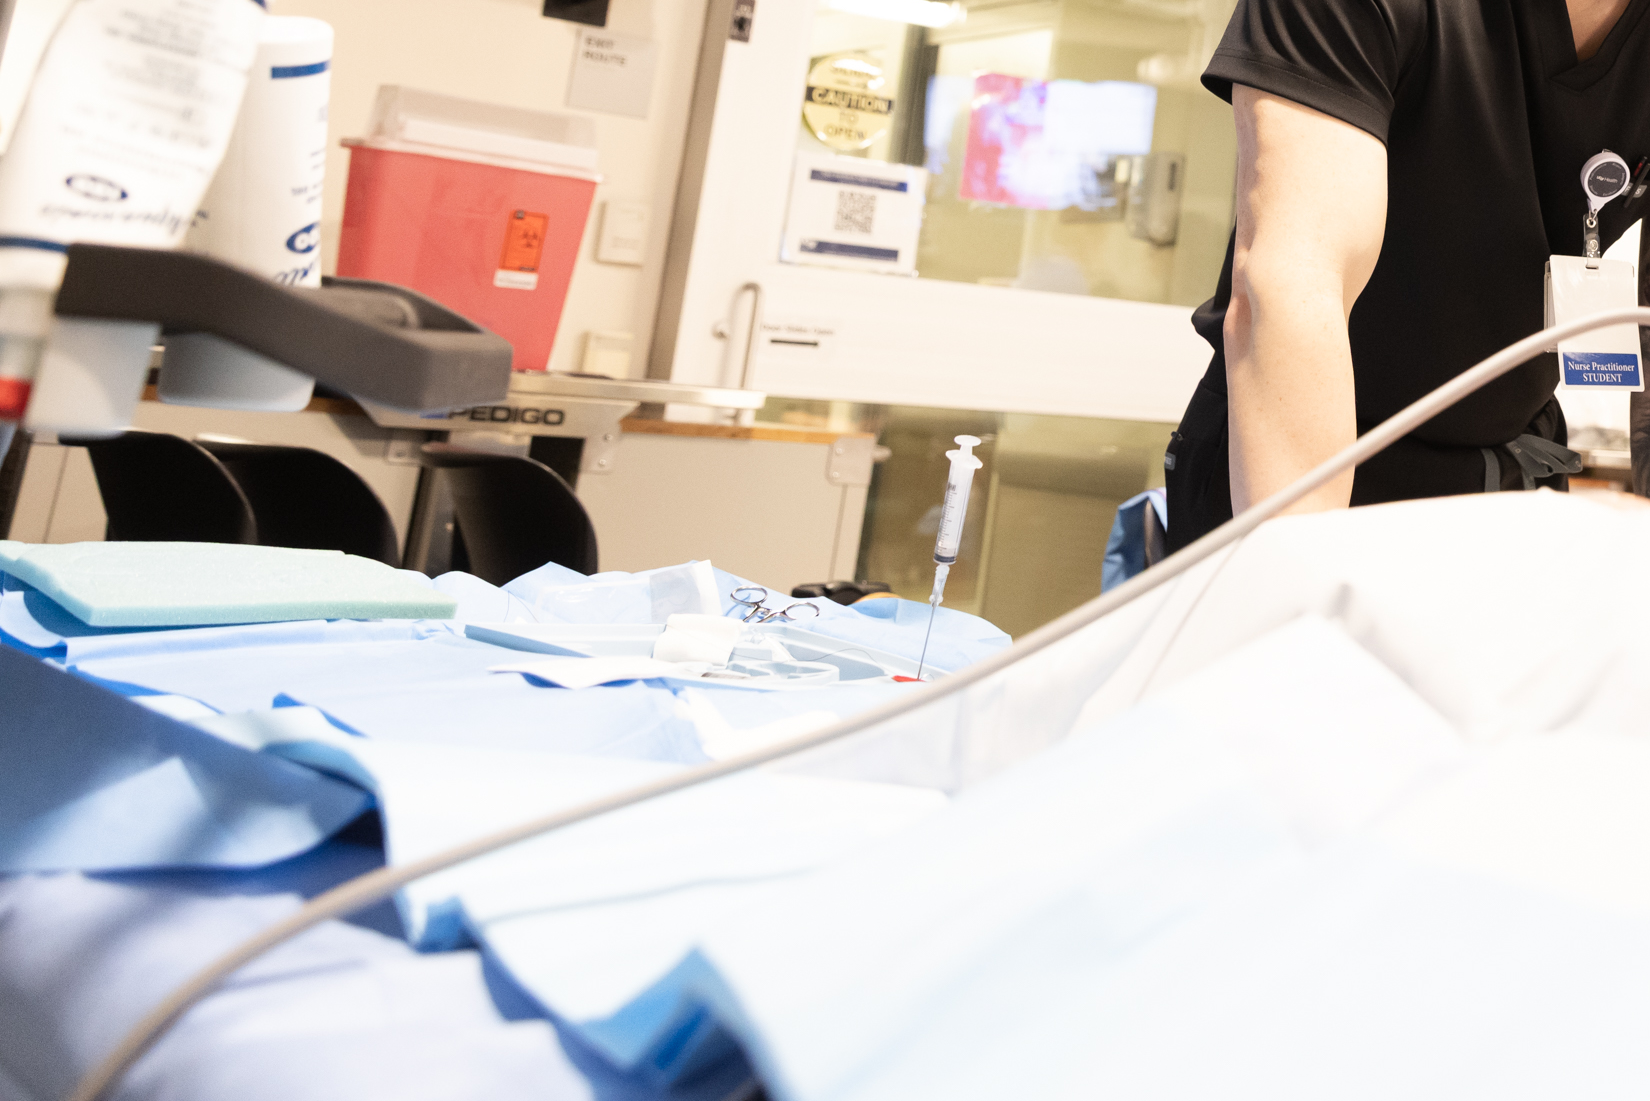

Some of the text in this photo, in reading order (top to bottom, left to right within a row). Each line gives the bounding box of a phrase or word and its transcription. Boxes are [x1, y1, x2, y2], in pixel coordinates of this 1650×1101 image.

[812, 87, 889, 113] CAUTION
[823, 123, 868, 141] OPEN
[1568, 361, 1635, 372] Nurse Practitioner
[1582, 373, 1622, 383] STUDENT
